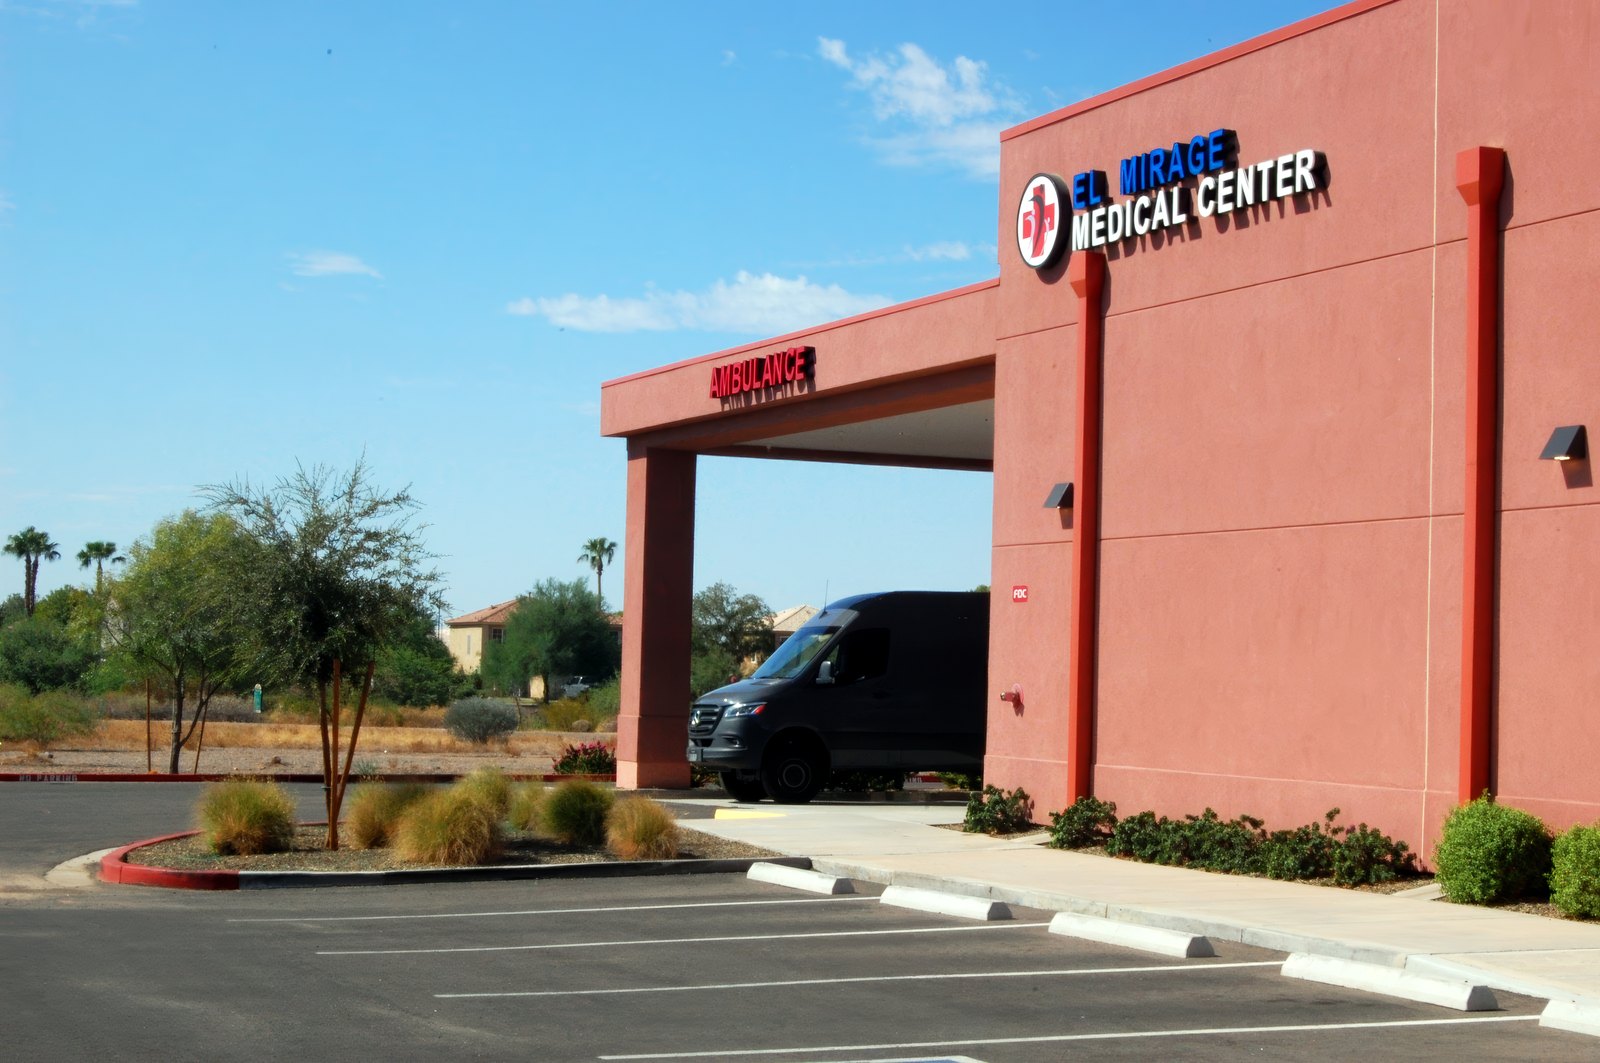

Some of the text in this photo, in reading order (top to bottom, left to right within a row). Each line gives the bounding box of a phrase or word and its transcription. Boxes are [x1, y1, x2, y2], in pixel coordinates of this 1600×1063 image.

[1071, 149, 1316, 251] MEDICAL CENTER
[1072, 128, 1226, 210] EL MIRAGE
[709, 346, 806, 398] AMBULANCE
[1013, 588, 1027, 599] FDC
